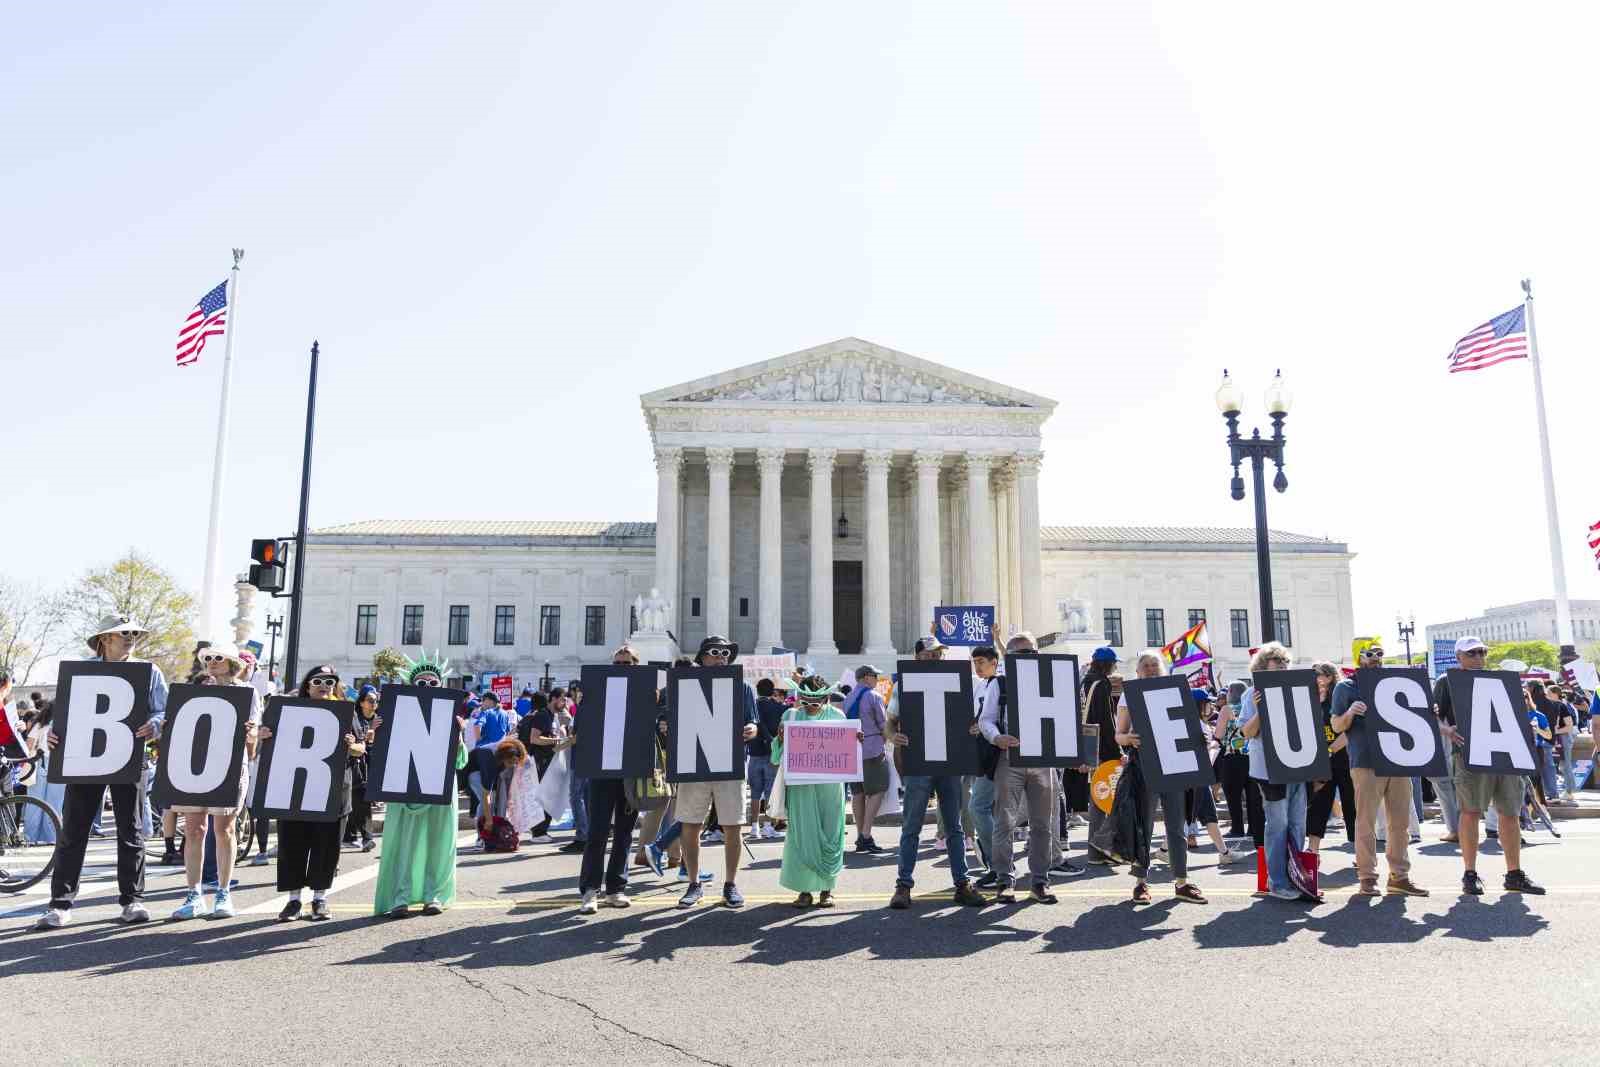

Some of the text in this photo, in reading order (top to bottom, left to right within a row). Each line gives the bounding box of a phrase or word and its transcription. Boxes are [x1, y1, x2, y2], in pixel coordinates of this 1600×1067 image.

[962, 611, 980, 619] ALL
[962, 617, 985, 628] ONE
[967, 625, 990, 634] ONE
[967, 633, 987, 642] ALL
[788, 752, 849, 769] BIRTHRIGHT
